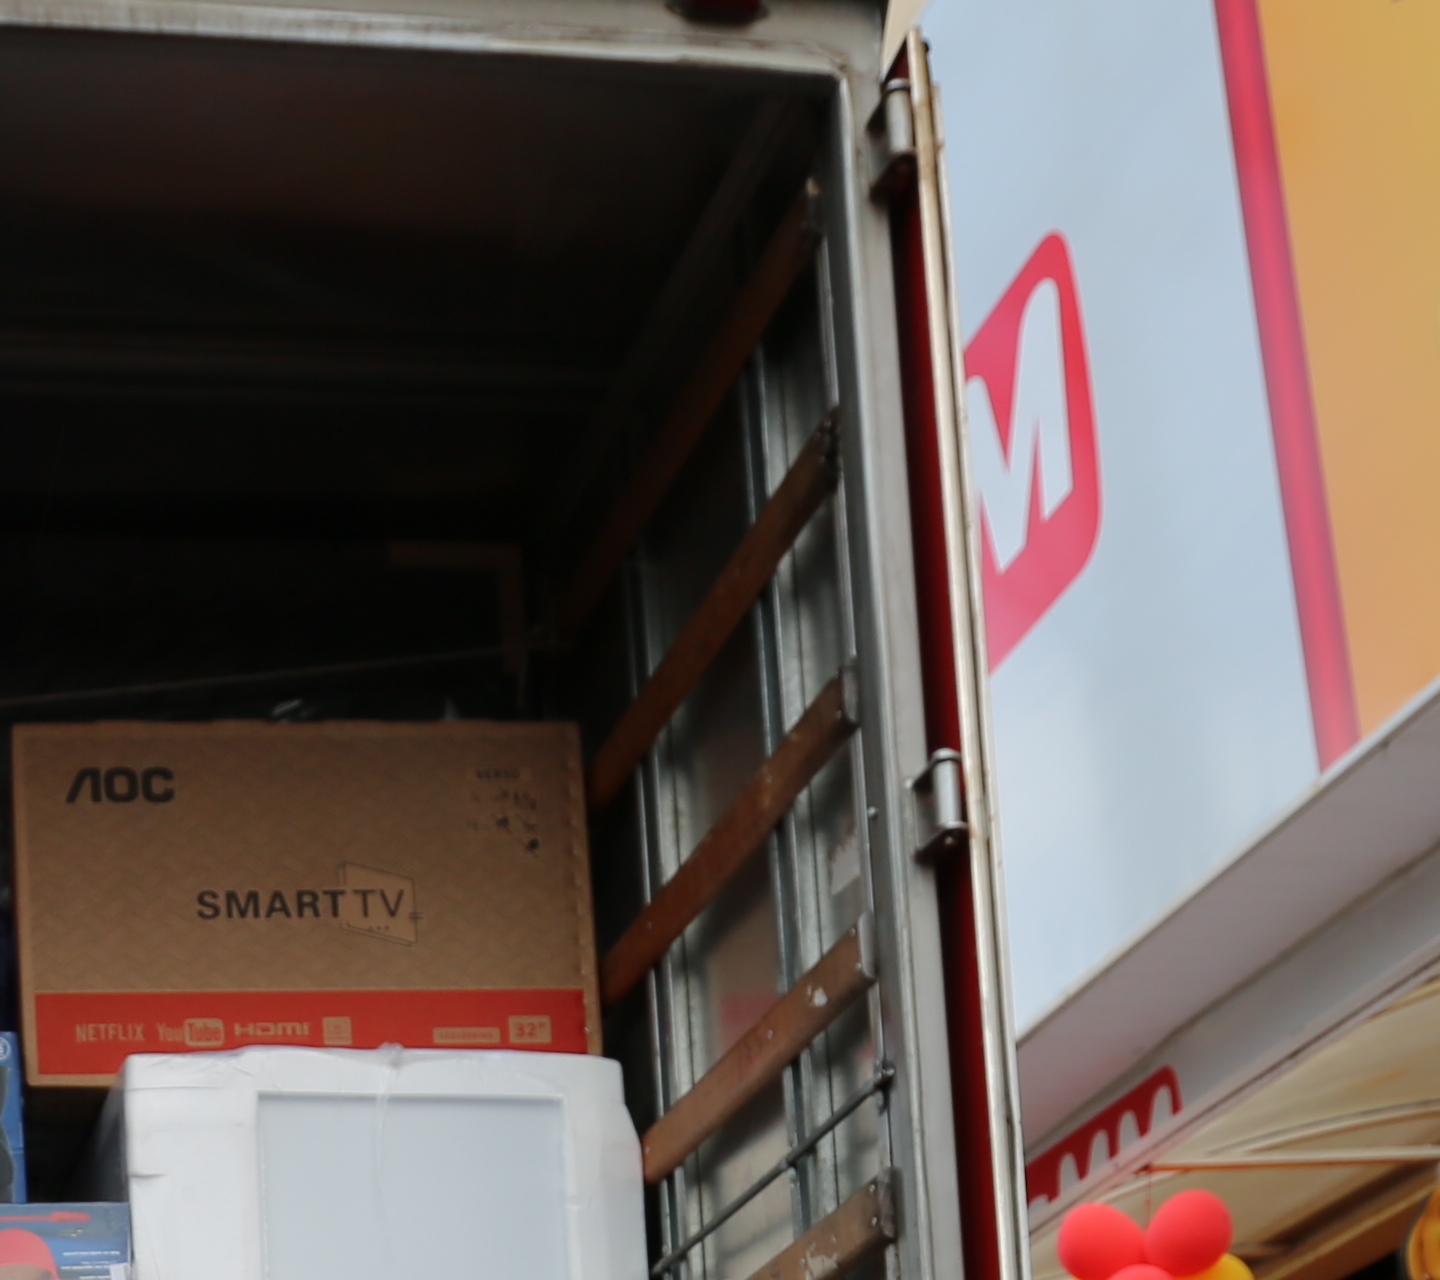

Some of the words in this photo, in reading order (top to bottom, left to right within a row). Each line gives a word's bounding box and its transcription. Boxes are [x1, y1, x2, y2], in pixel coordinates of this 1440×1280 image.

[66, 767, 175, 803] AOC
[197, 889, 345, 920] SMART
[352, 889, 405, 919] TV
[75, 1023, 146, 1043] NETFLIX
[233, 1021, 311, 1037] HDMI
